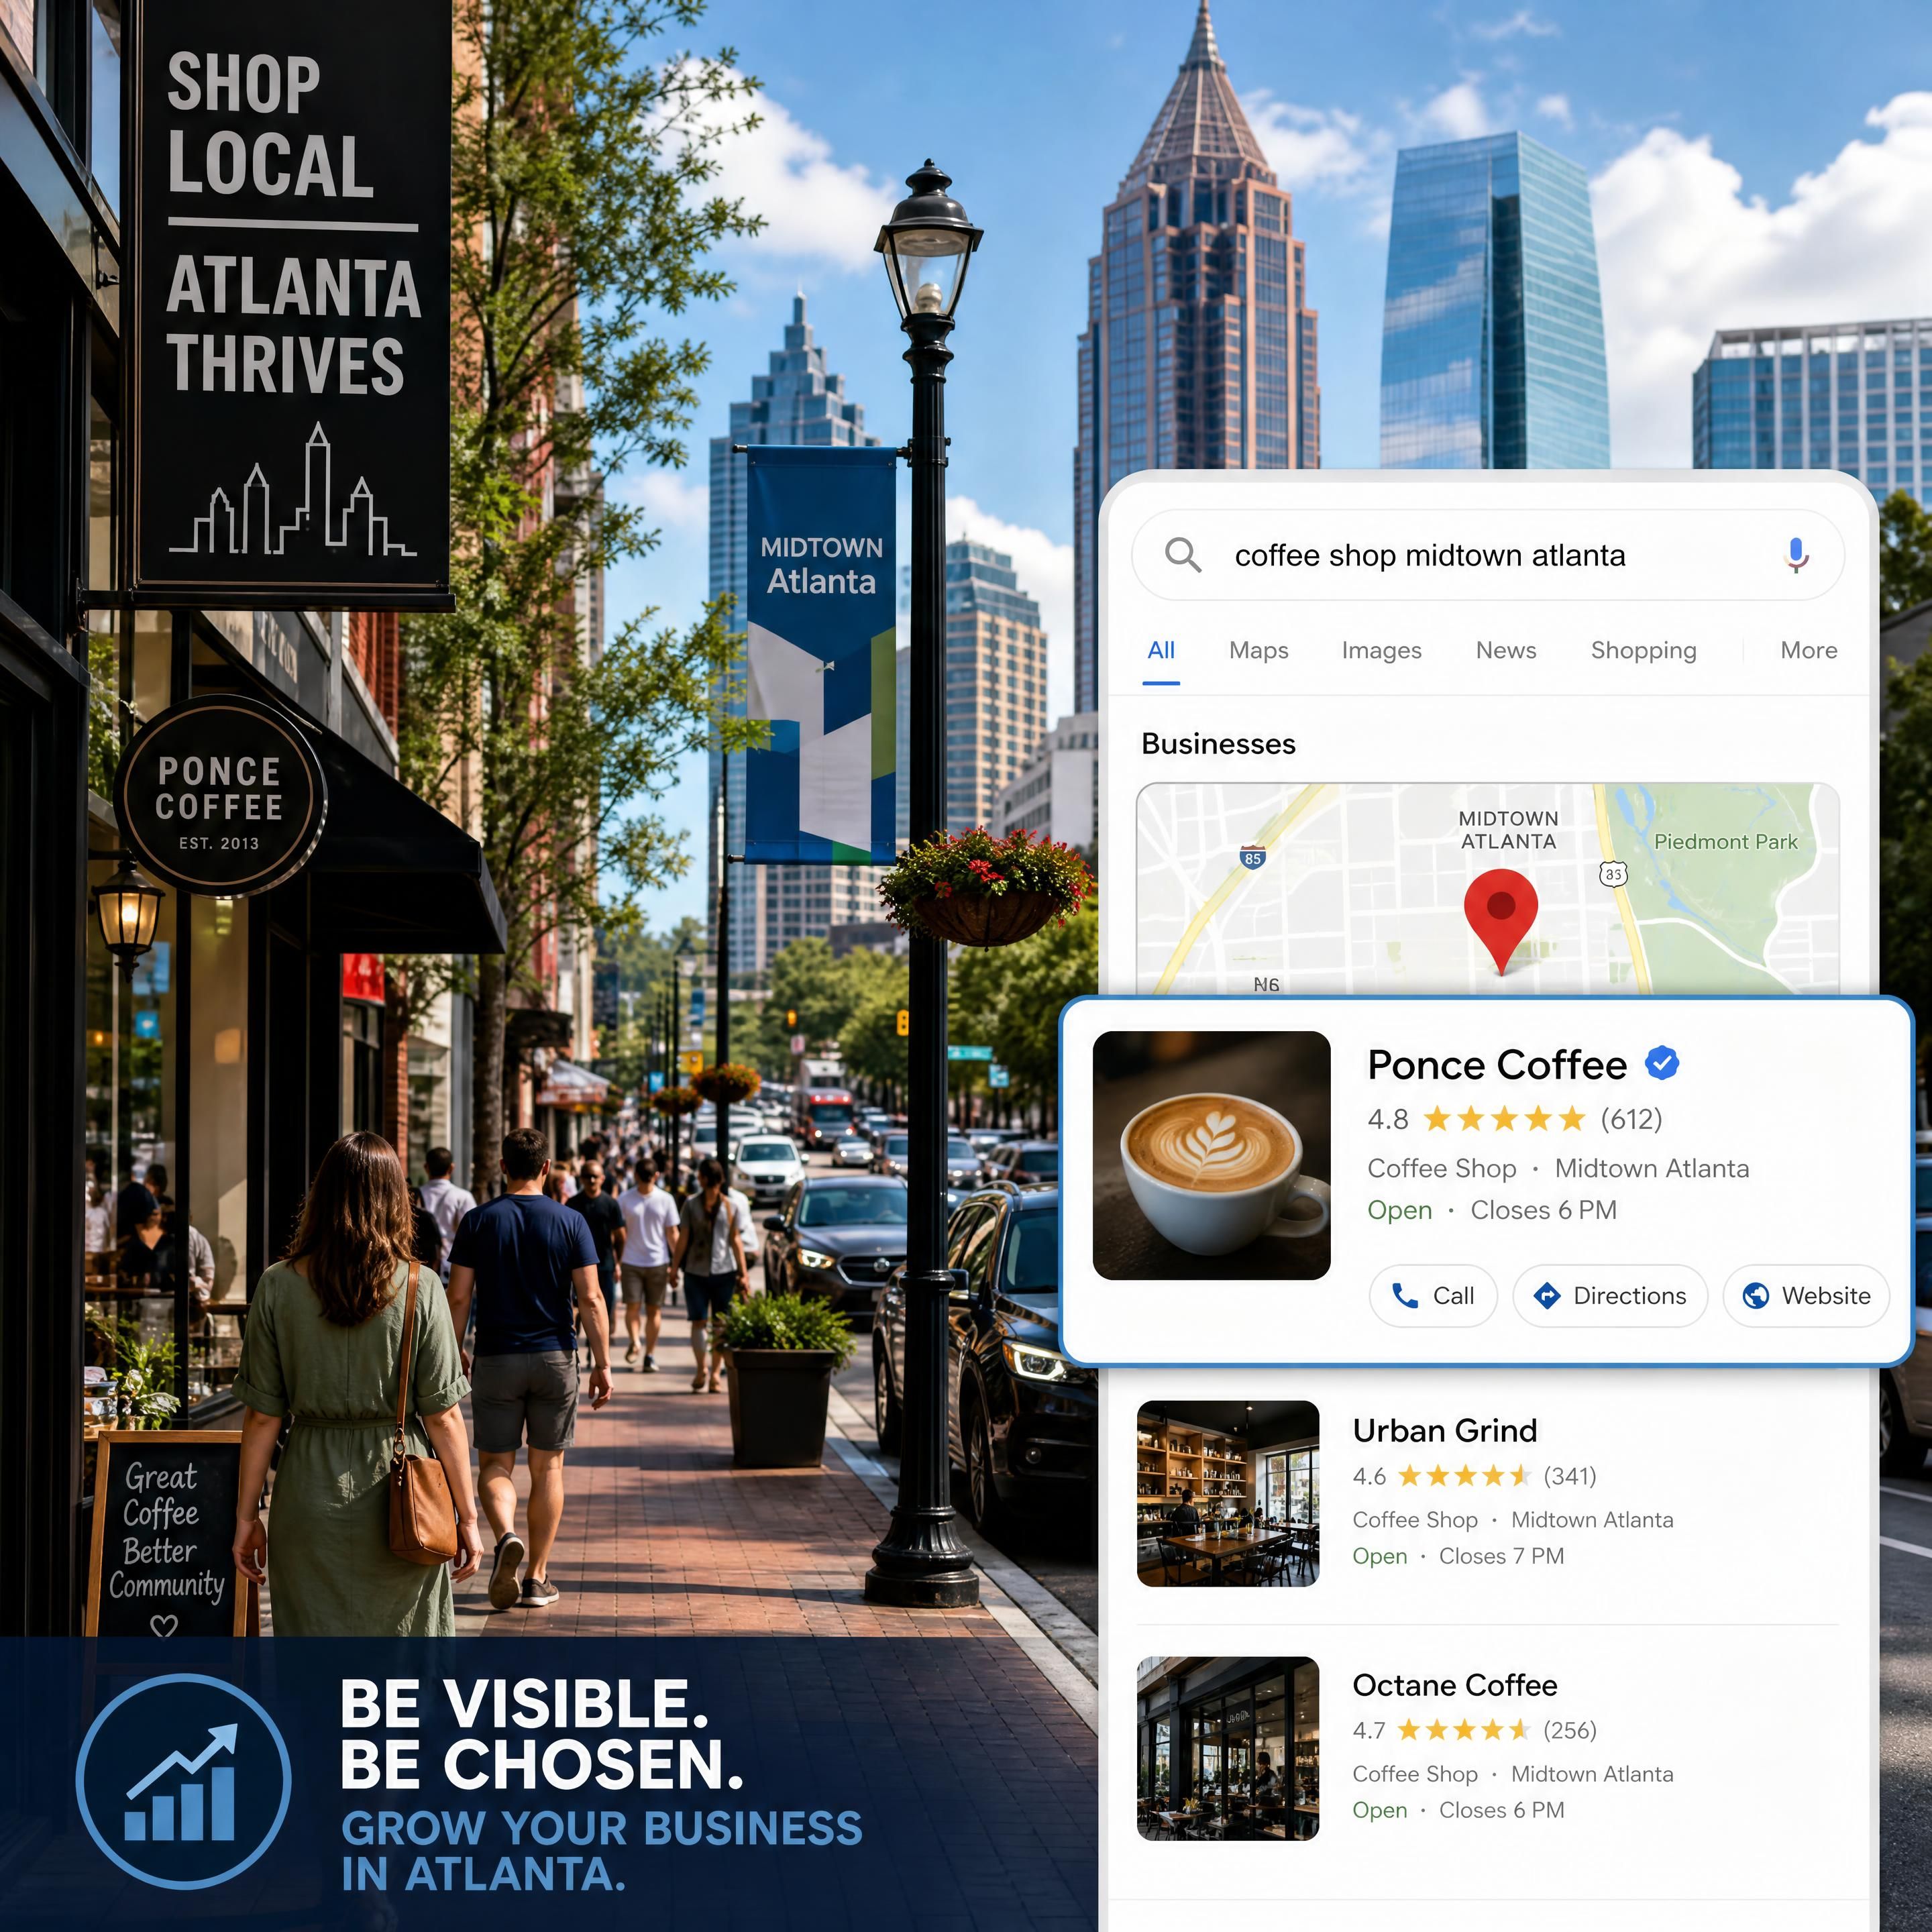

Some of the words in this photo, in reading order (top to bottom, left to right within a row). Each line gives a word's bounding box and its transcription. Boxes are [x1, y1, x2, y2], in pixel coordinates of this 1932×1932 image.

[168, 51, 319, 113] SHOP
[170, 130, 373, 197] LOCAL
[166, 255, 421, 317] ATLANTA
[166, 333, 403, 395] THRIVES
[761, 537, 883, 558] MIDTOWN
[767, 567, 876, 594] Atlanta
[159, 756, 280, 786] PONCE
[156, 793, 282, 820] COFFEE
[180, 837, 213, 849] EST.
[221, 837, 259, 850] 2013
[125, 1461, 198, 1494] Great
[123, 1496, 199, 1530] Coffee
[123, 1537, 198, 1565] Better
[109, 1569, 225, 1606] Community
